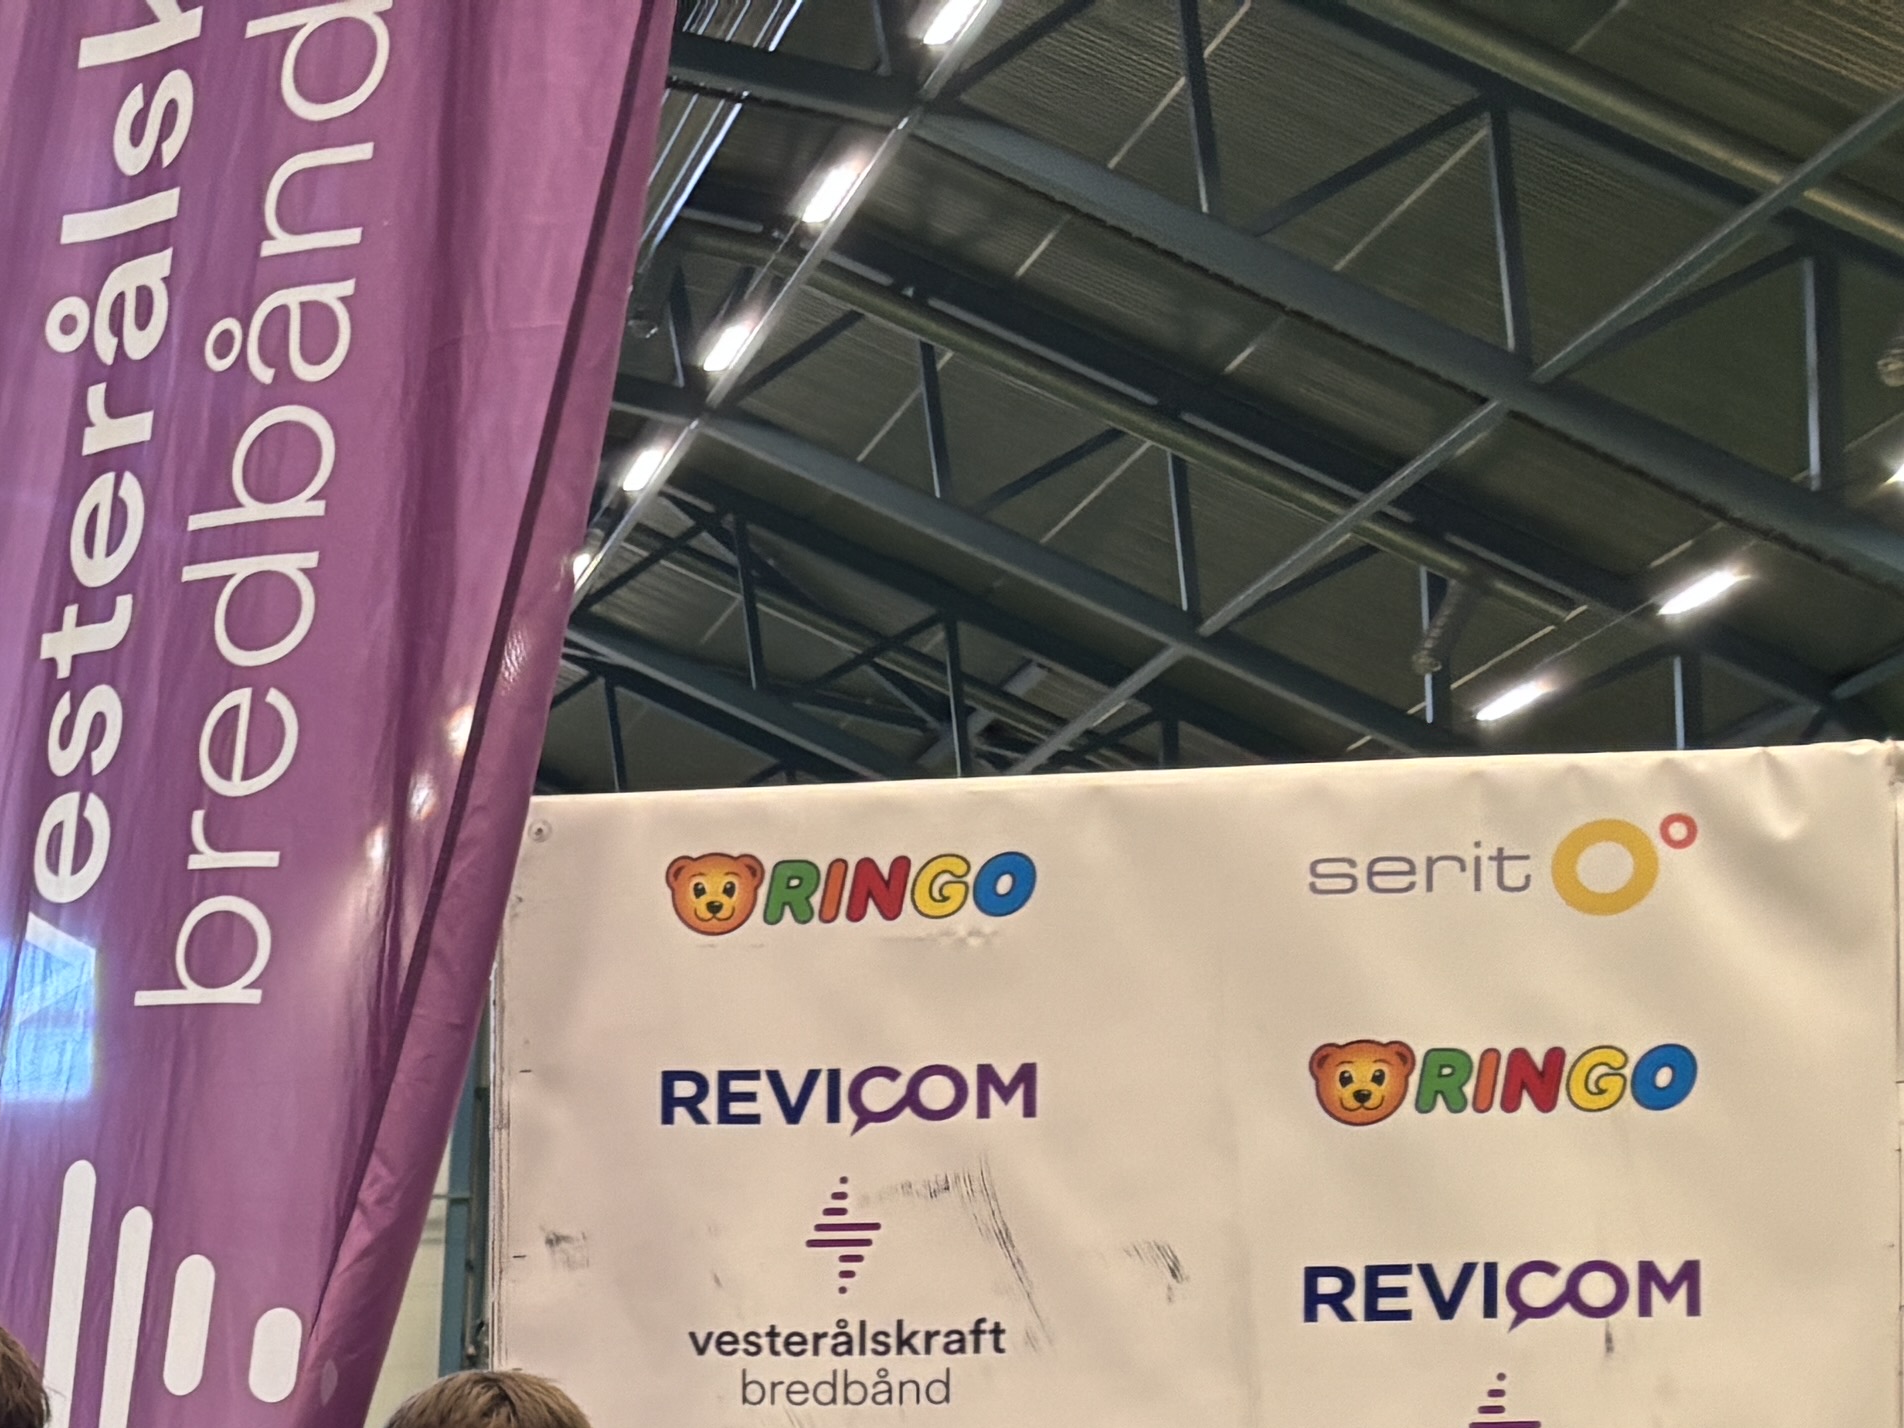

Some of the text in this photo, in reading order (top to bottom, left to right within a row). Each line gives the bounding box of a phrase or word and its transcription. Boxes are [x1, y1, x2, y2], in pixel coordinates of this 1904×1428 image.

[134, 0, 392, 1006] bredbånd
[763, 851, 1037, 925] RINGO
[1307, 840, 1532, 896] serit
[660, 1062, 1038, 1136] REVICOM
[1415, 1042, 1698, 1114] RINGO
[1303, 1258, 1702, 1331] REVICOM
[689, 1316, 1006, 1360] vesterålskraft
[740, 1368, 950, 1407] bredbånd
